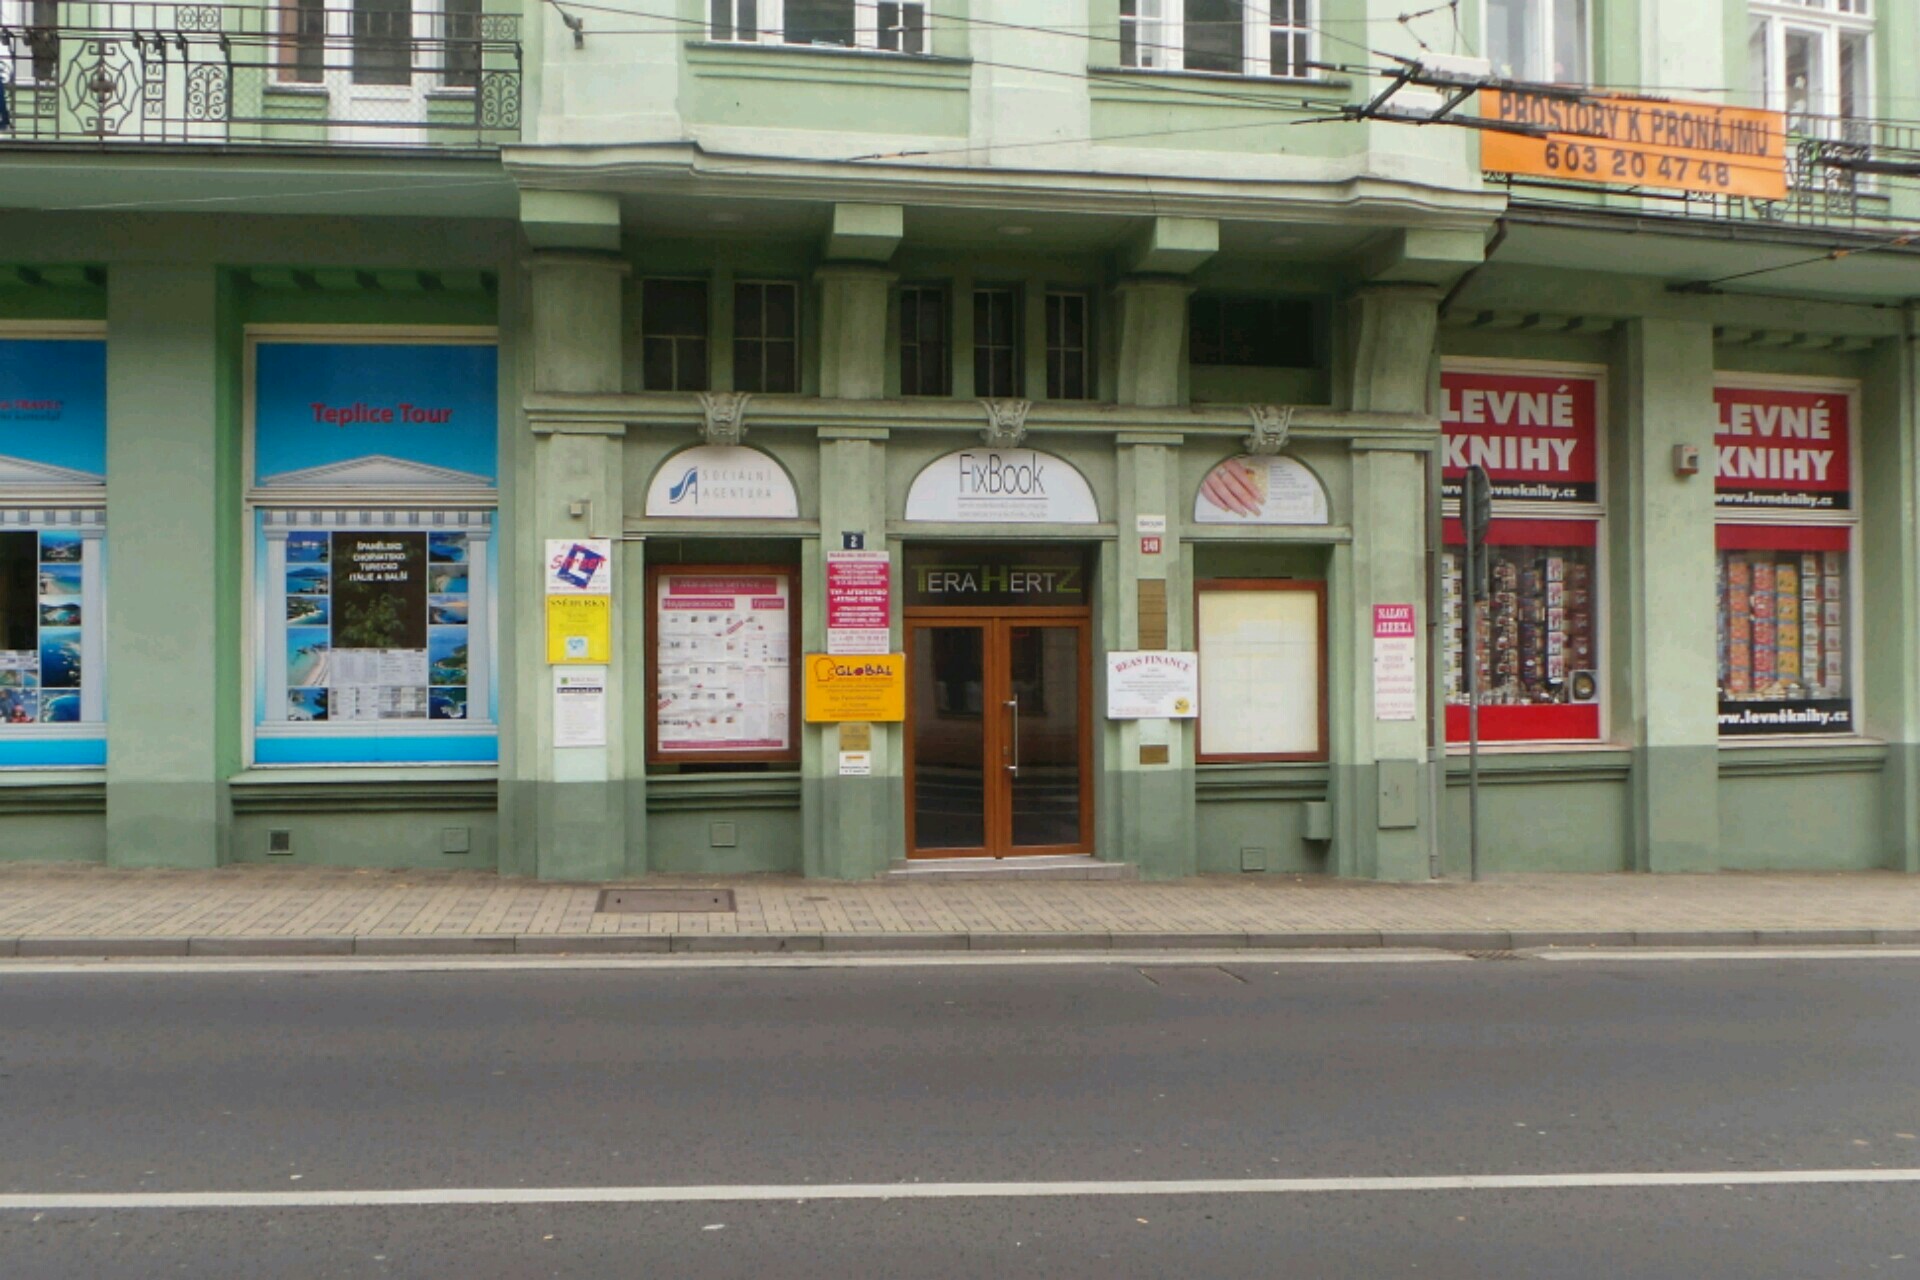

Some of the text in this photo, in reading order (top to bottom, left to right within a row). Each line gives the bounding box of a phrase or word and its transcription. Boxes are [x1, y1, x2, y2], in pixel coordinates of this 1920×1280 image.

[1627, 106, 1642, 143] K
[1651, 107, 1769, 157] PRONÁJMU
[1545, 141, 1730, 187] 603 20 47 48
[311, 402, 453, 428] Teplice Tour
[1441, 384, 1574, 428] LEVNÉ
[1714, 399, 1831, 440] LEVNÉ
[960, 452, 1045, 494] FixBook
[1441, 433, 1578, 472] KNIHY
[1714, 445, 1835, 481] KNIHY
[850, 535, 858, 548] 2
